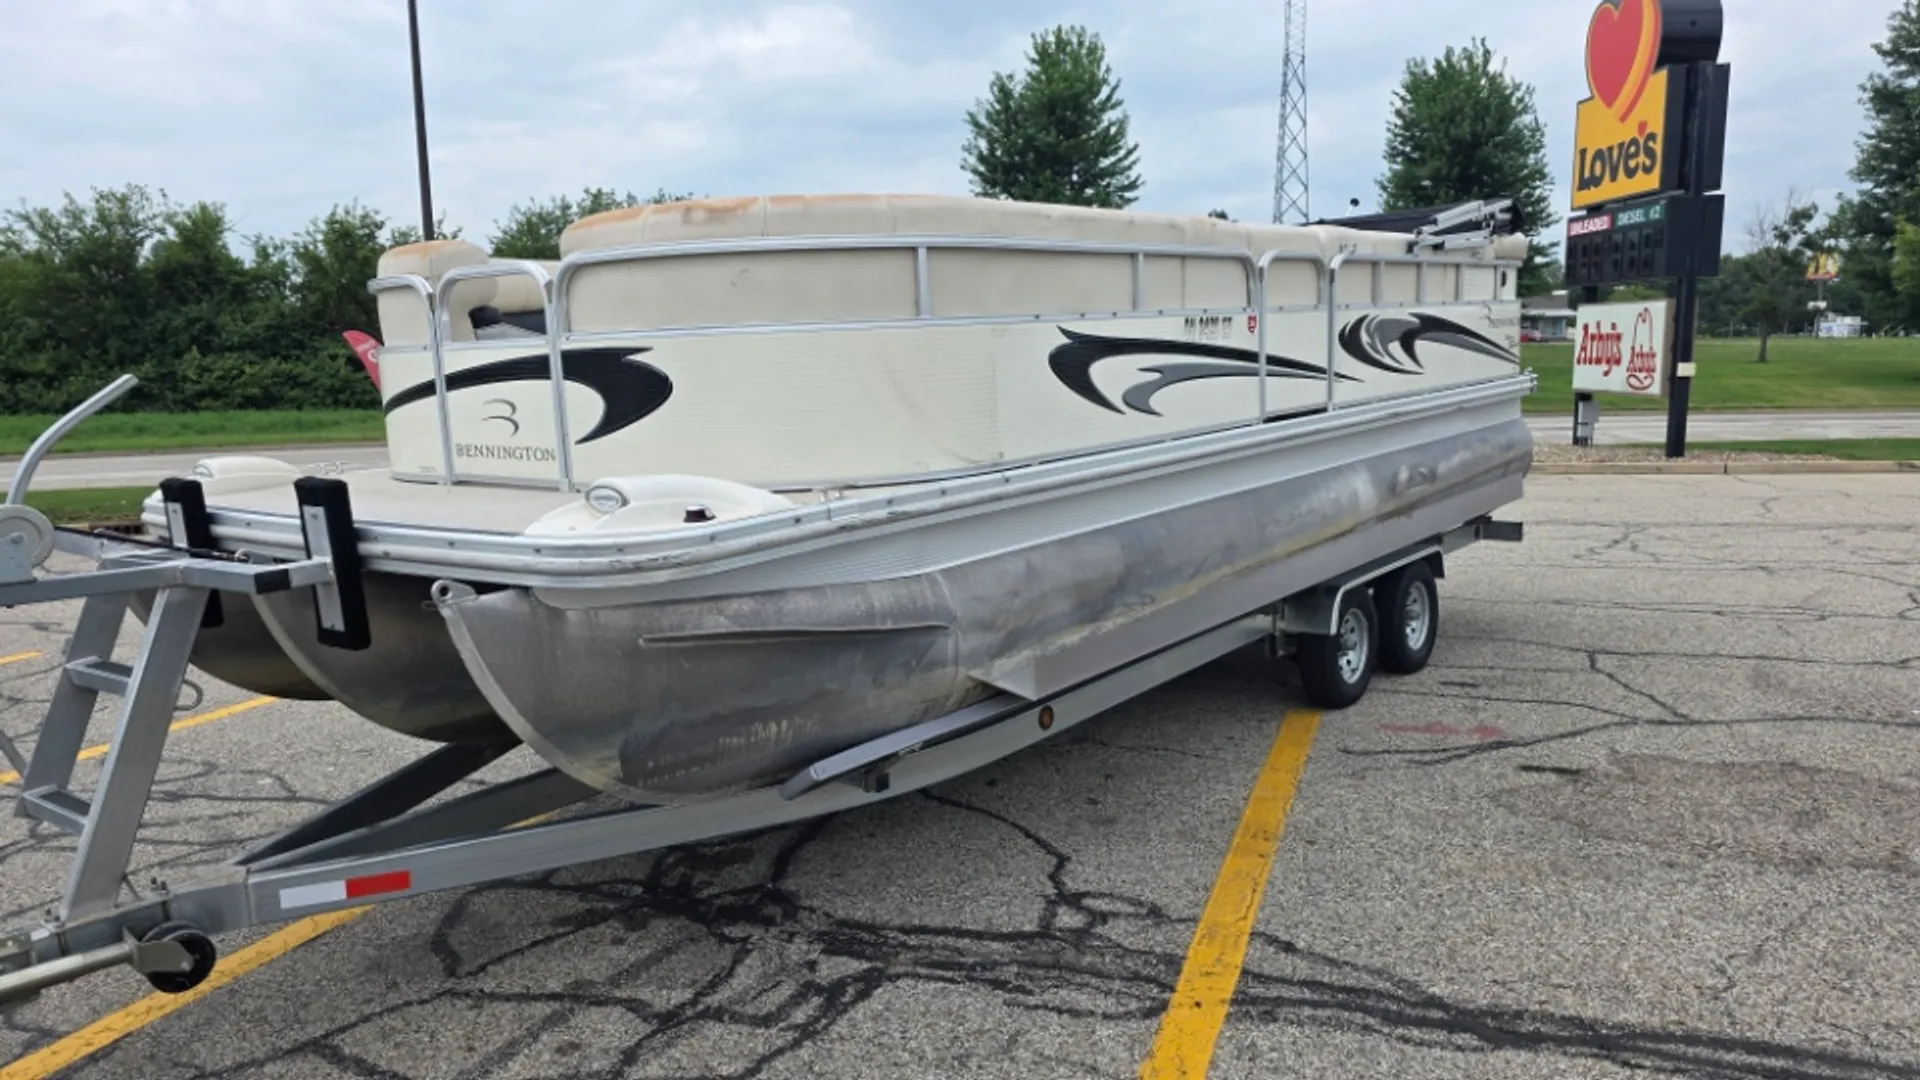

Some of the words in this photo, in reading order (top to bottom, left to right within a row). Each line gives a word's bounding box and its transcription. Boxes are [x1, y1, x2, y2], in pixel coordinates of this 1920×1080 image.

[1576, 122, 1658, 192] Love's
[1617, 207, 1646, 226] DIESEL
[1576, 320, 1622, 377] Arby's
[455, 443, 556, 462] BENNINGTON
